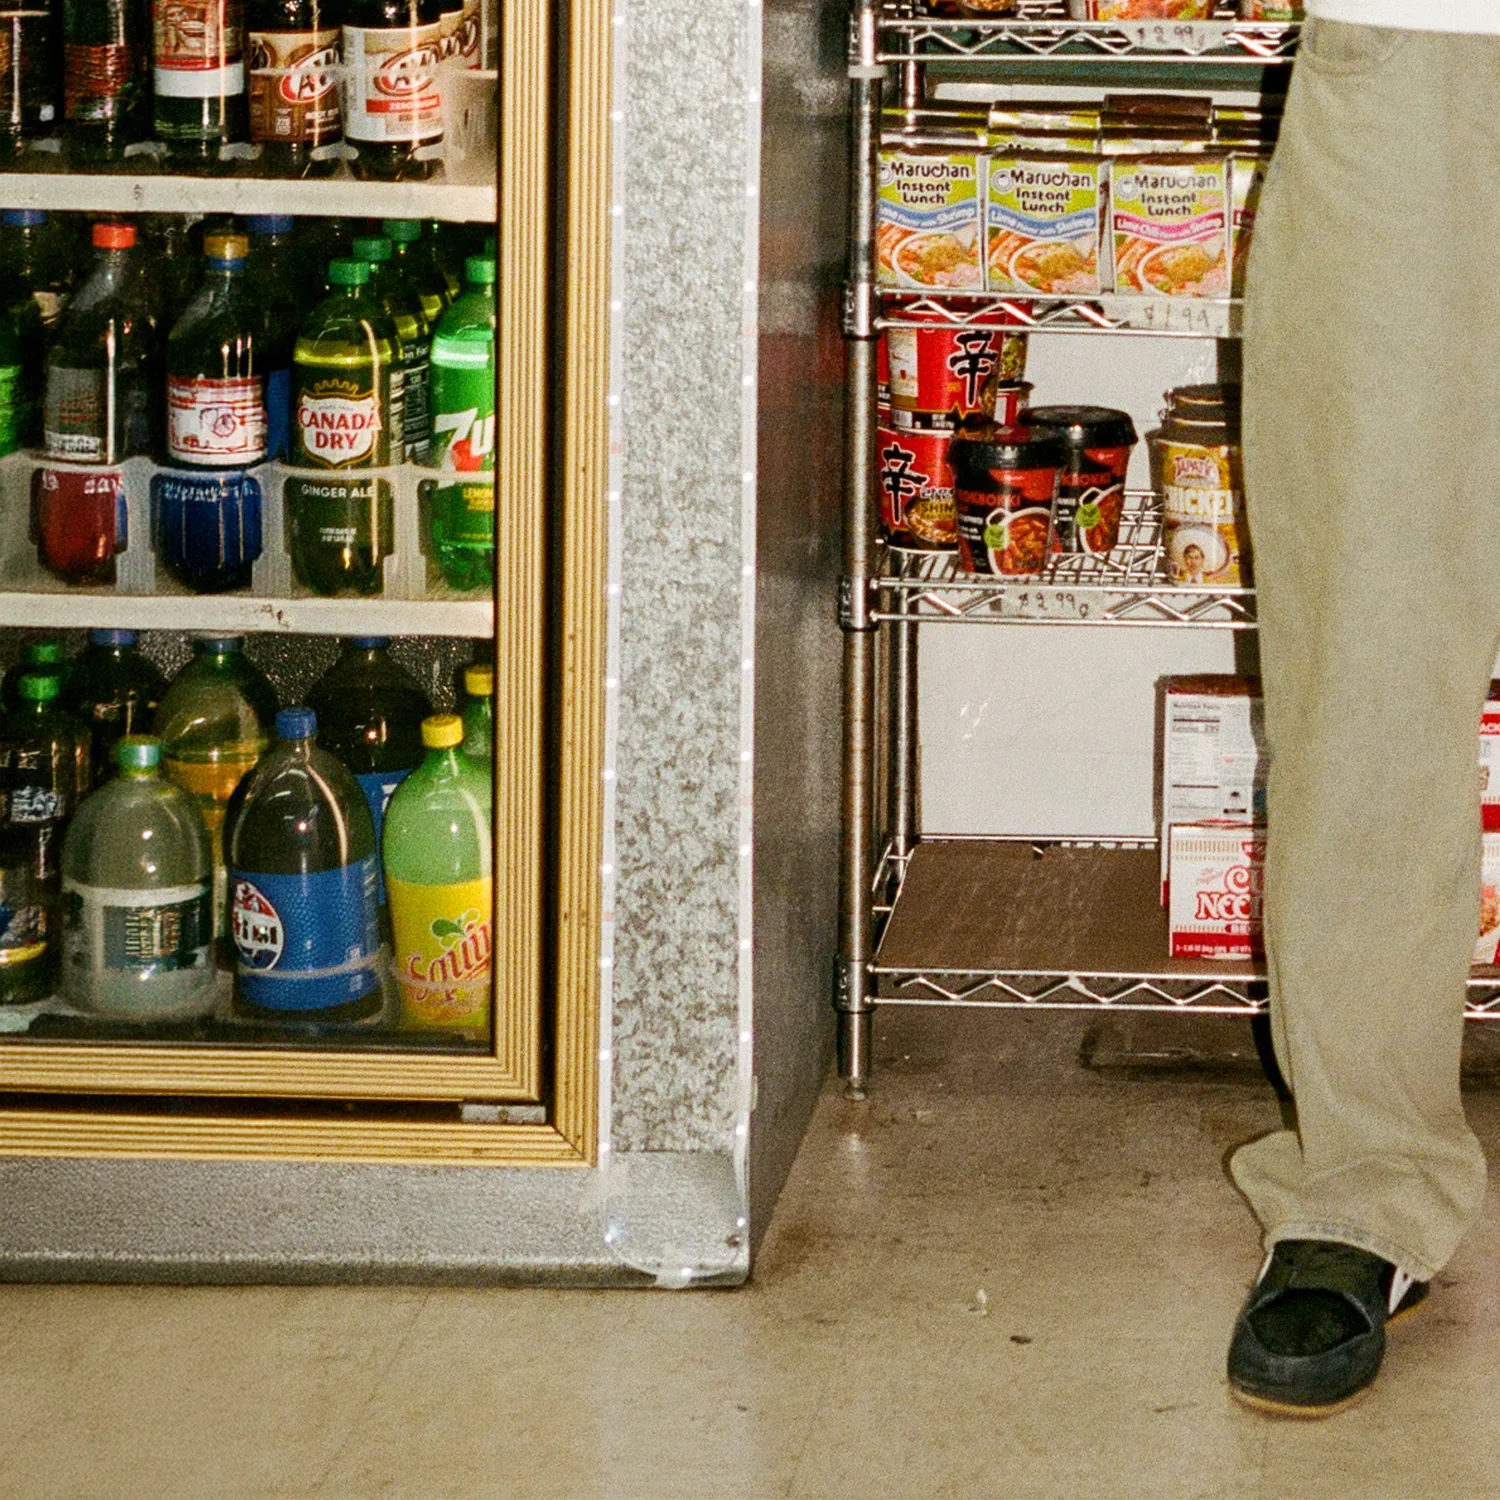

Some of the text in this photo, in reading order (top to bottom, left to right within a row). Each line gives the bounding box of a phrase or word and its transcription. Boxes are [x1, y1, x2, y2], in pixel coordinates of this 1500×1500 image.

[890, 162, 970, 179] Maruchan
[1010, 169, 1091, 187] Maruchan
[896, 180, 951, 192] Instant
[1134, 174, 1218, 189] Maruchan
[903, 192, 946, 205] Lunch
[1015, 187, 1071, 201] Instant
[1141, 192, 1197, 204] Instant
[1022, 200, 1065, 214] Lunch
[1147, 204, 1192, 217] Lunch
[946, 330, 999, 409] 辛
[299, 406, 382, 431] CANADA
[314, 430, 359, 451] DRY
[301, 483, 376, 498] GINGER ALE
[879, 441, 930, 527] 辛
